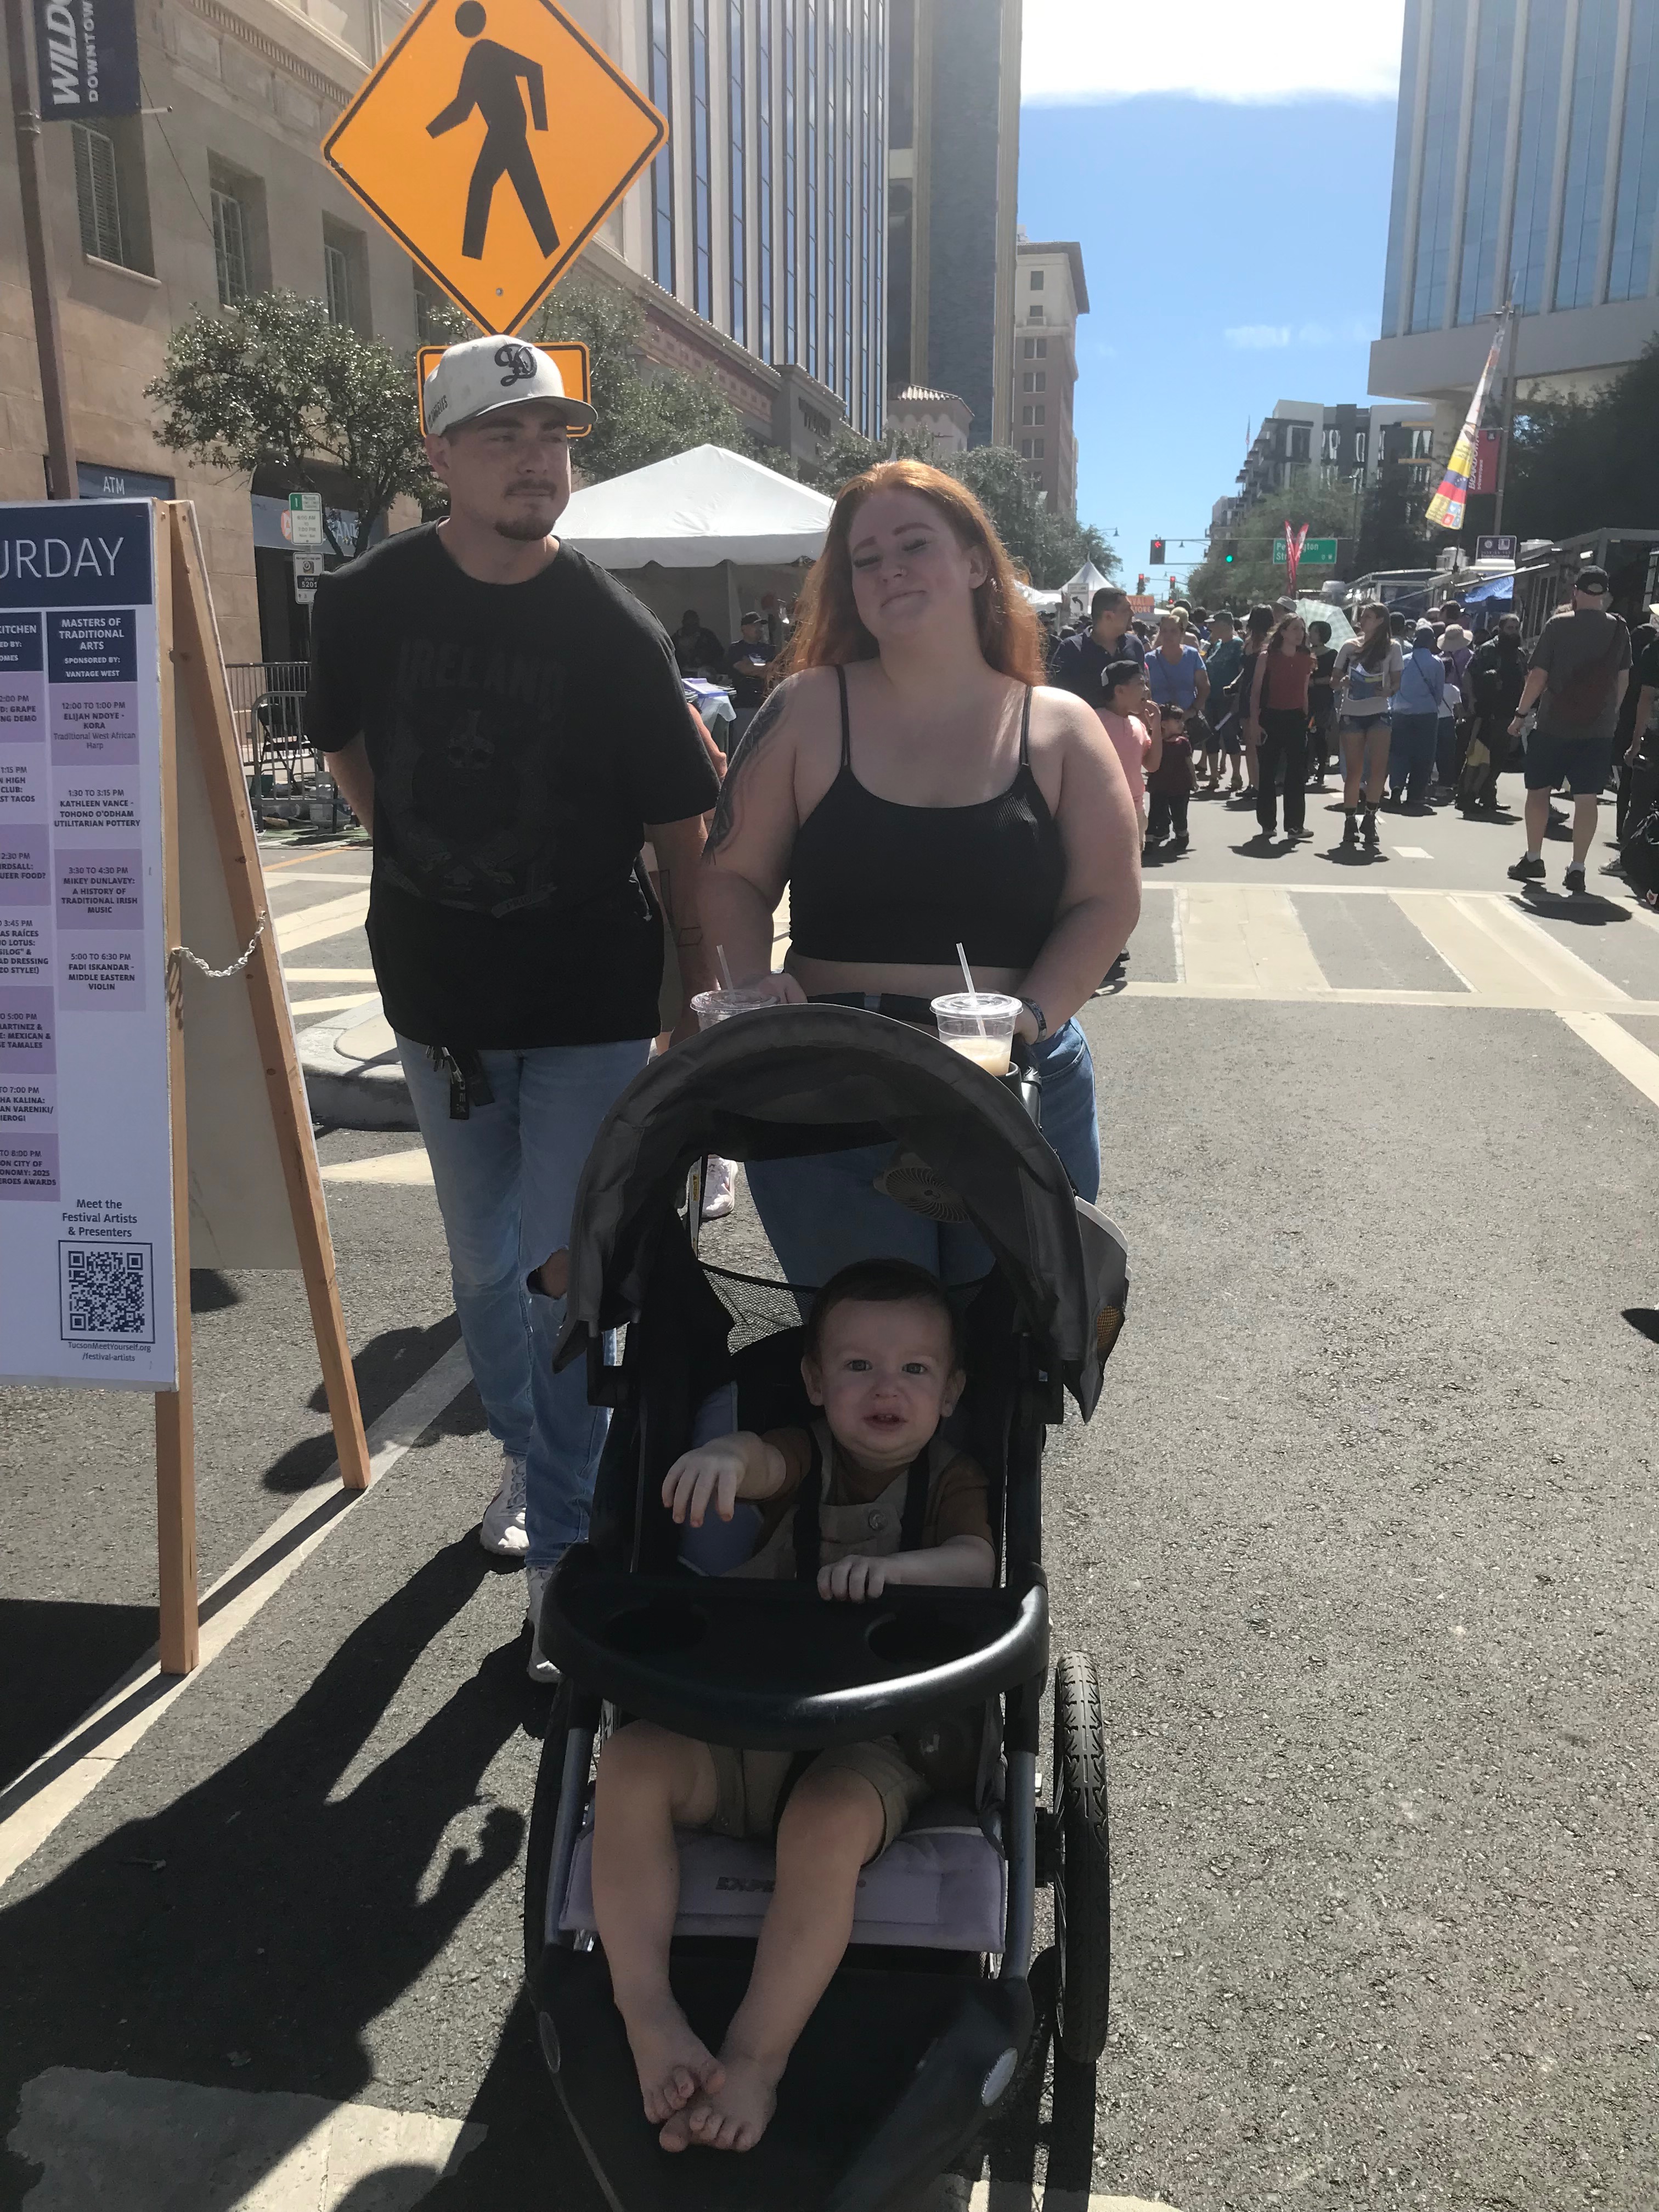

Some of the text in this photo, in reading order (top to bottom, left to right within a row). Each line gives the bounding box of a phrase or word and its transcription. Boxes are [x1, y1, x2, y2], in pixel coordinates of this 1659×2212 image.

[47, 0, 80, 105] WILD
[103, 476, 125, 495] ATM
[61, 618, 121, 627] MASTERS OF
[59, 630, 125, 639] TRADITIONAL
[80, 641, 104, 650] ARTS
[64, 713, 90, 721] ELIJAH
[87, 742, 104, 751] Harp
[12, 928, 39, 937] RAÍCES
[13, 1106, 54, 1114] VARENIKI/
[77, 1199, 122, 1209] Meet the
[63, 1212, 138, 1223] Festival Artists
[68, 1226, 132, 1237] & Presenters
[68, 1341, 151, 1353] TucsonMeetYourself.org
[82, 1352, 136, 1362] /festival-artists
